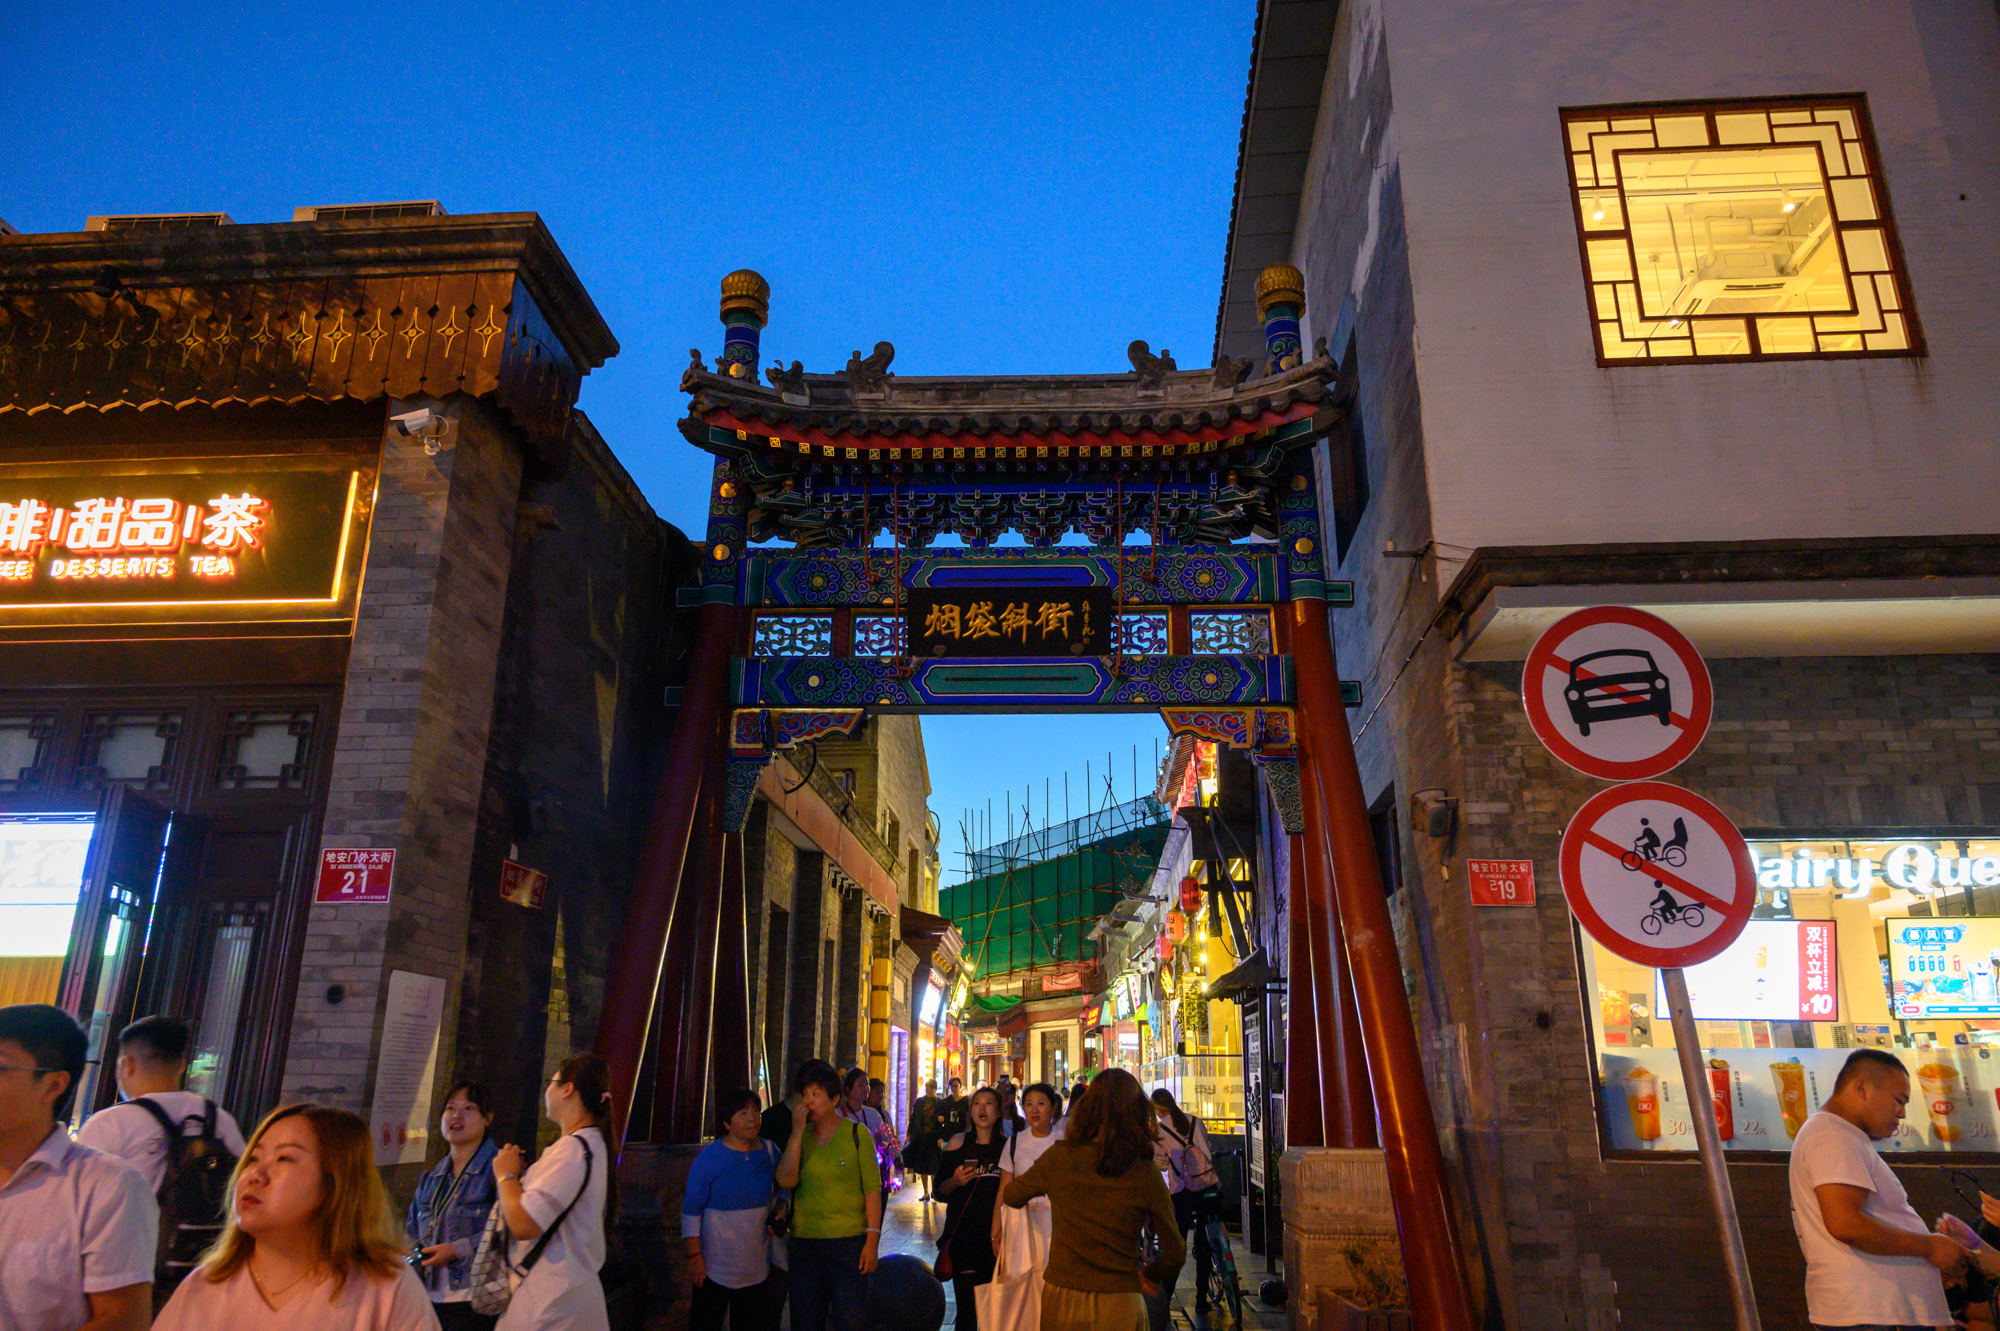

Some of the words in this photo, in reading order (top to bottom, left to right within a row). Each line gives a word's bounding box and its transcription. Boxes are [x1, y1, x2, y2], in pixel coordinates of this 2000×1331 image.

[66, 496, 176, 551] 甜品
[202, 493, 264, 547] 茶
[50, 557, 171, 577] DESSERTS
[190, 556, 232, 575] TEA
[923, 601, 1075, 644] 烟袋斜街
[325, 851, 392, 863] 地安门外大街
[1471, 862, 1529, 873] 地安门外大街
[341, 870, 369, 894] 21
[1806, 926, 1824, 991] 双杯立减
[1637, 1102, 1653, 1111] DQ
